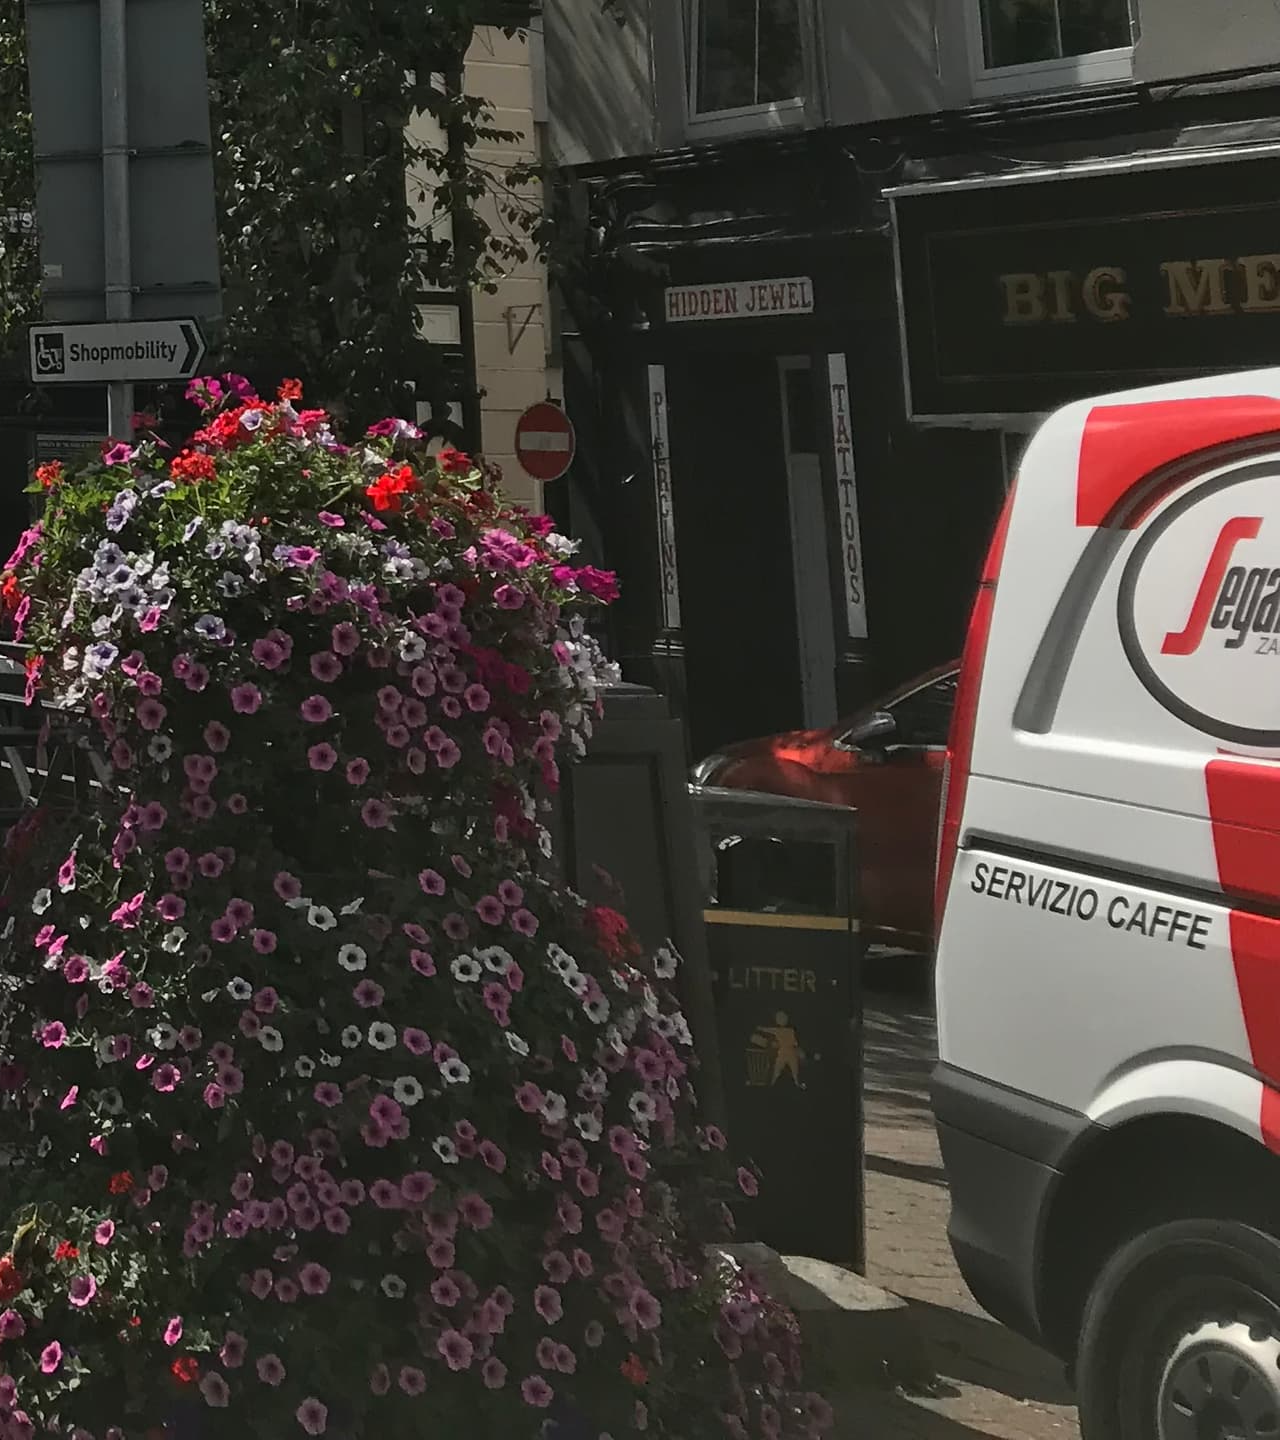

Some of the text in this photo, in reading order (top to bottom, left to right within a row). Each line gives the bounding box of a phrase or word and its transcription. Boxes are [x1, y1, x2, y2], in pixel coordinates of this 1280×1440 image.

[667, 281, 812, 318] HIDDEN JEWEL
[1001, 253, 1280, 326] BIG ME
[69, 339, 178, 365] Shopmobility
[831, 383, 861, 605] TATTOOS
[970, 862, 1214, 951] SERVIZIO CAFFE
[728, 966, 817, 993] LITTER
